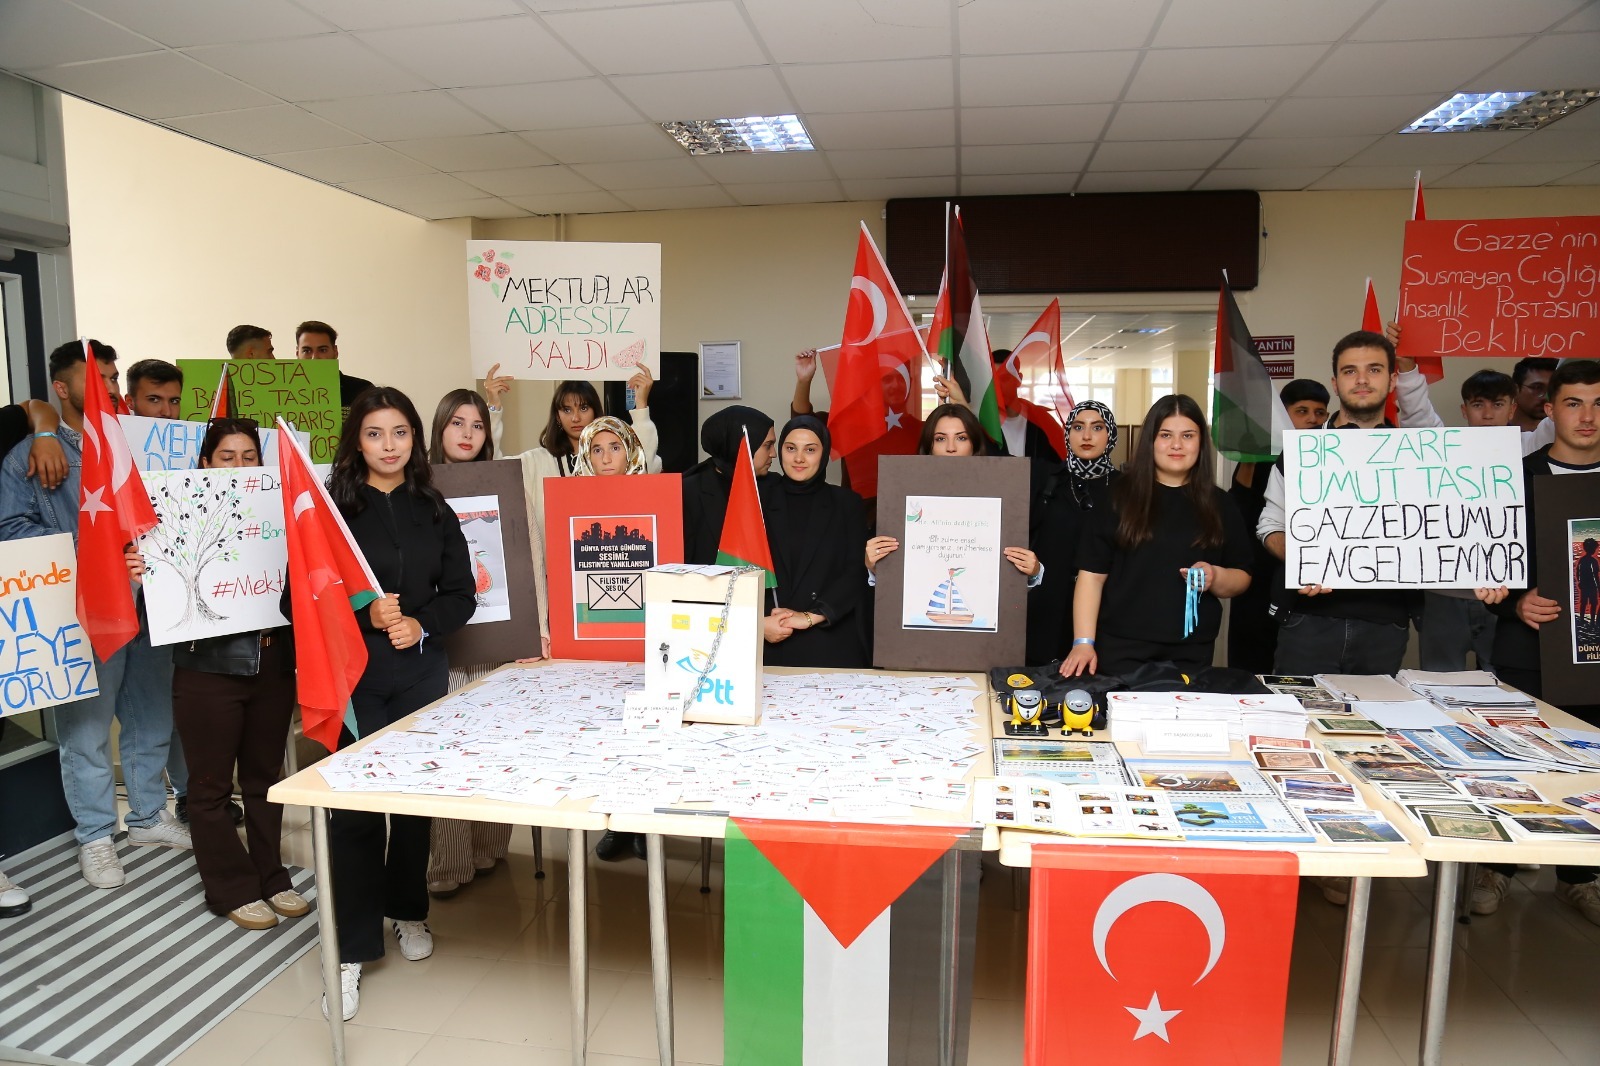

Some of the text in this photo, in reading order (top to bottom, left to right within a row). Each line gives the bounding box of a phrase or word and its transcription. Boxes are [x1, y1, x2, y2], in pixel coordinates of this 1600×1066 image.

[1453, 221, 1598, 252] Gazze'nin
[1404, 254, 1512, 290] Susmayan
[501, 275, 654, 304] MEKTUPLAR
[1402, 288, 1470, 318] İnsanlık
[505, 305, 634, 335] ADRESSİZ
[1254, 340, 1292, 351] ANTİN
[1433, 317, 1586, 357] Bekliyor
[527, 339, 609, 370] KALDI
[222, 362, 311, 386] POSTA
[192, 387, 330, 408] BAIŞ TAŞIR
[1298, 429, 1462, 468] BİR ZARF
[1298, 465, 1517, 505] UMUT TAŞIR
[580, 544, 600, 552] DÜNYA
[620, 543, 647, 551] GÜNÜNDE
[598, 551, 629, 561] SESİMİZ
[610, 560, 650, 568] YANKILANSIN
